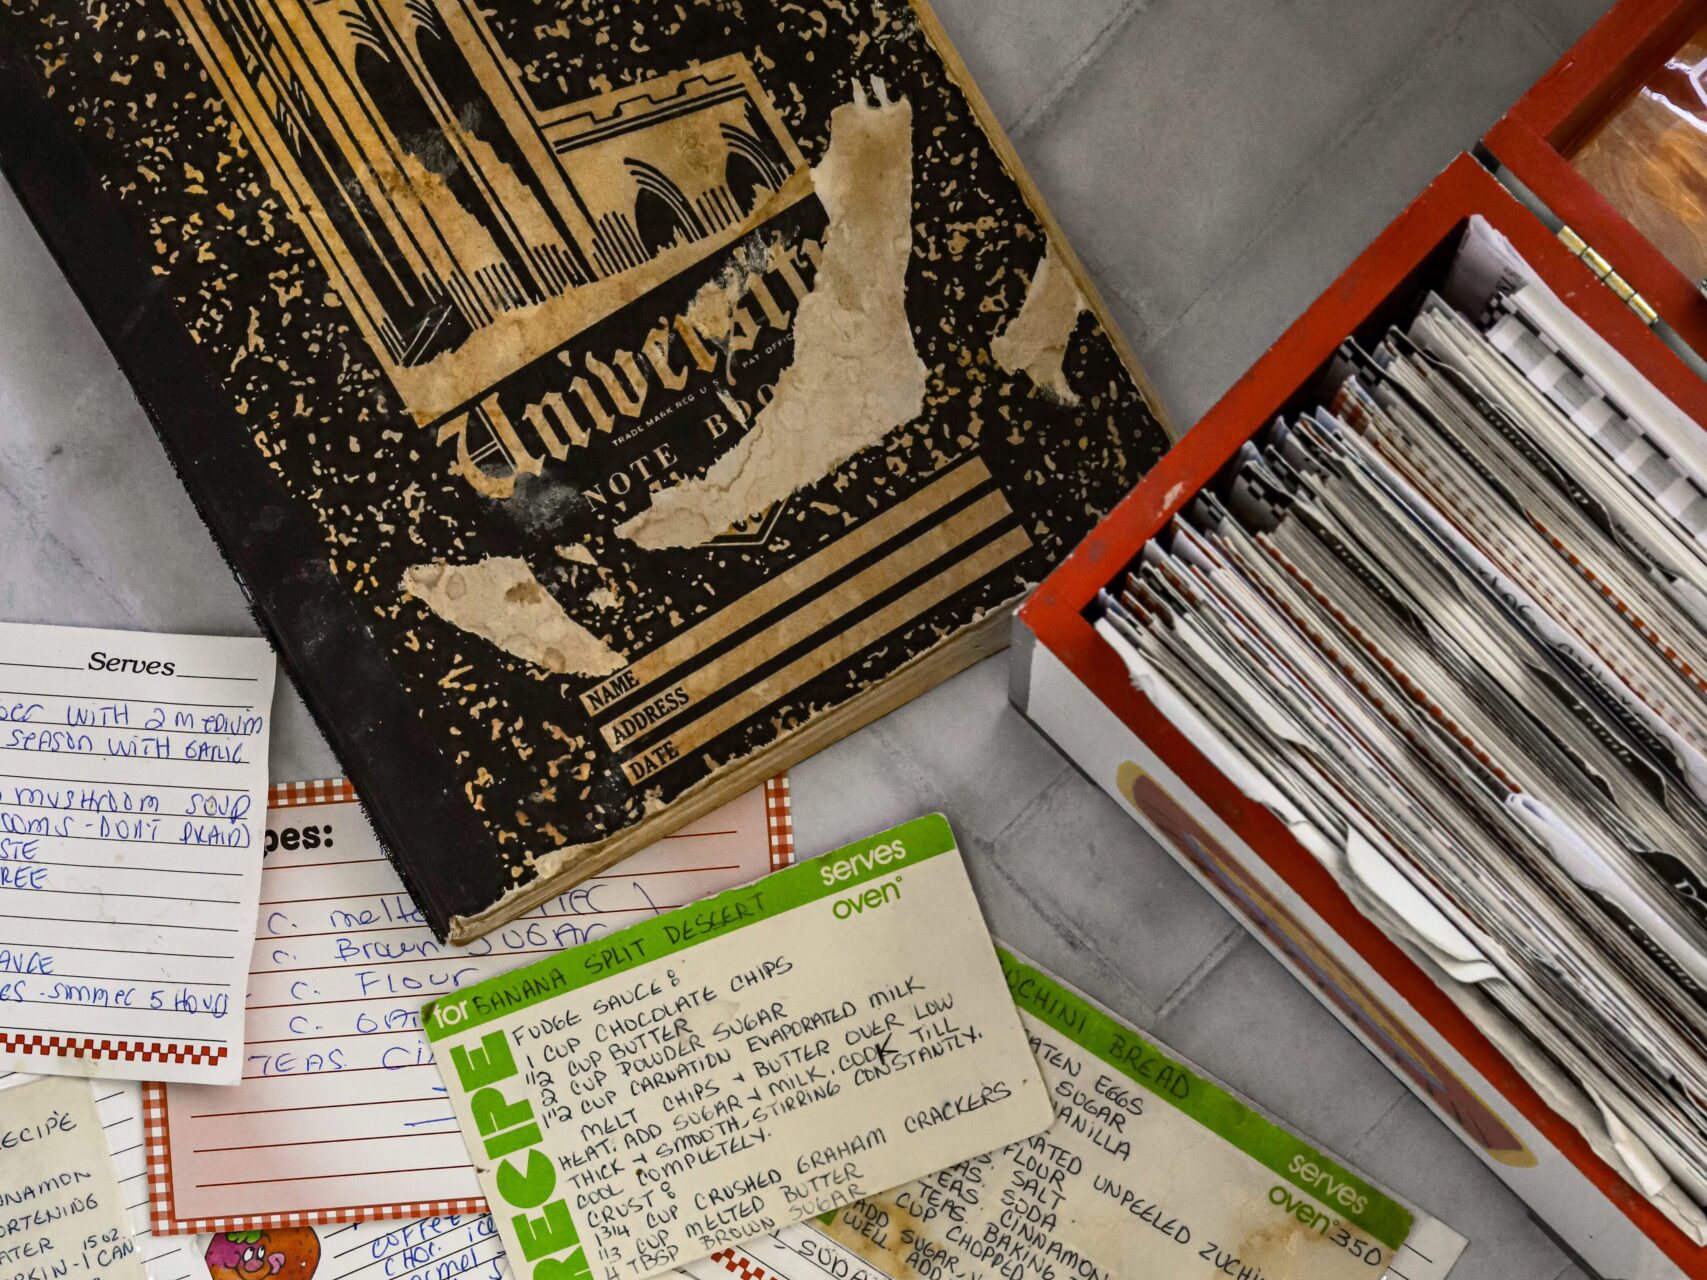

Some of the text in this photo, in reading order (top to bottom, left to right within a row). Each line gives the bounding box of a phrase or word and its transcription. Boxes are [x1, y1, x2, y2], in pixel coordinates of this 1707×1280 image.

[612, 426, 644, 447] TRADE
[647, 407, 674, 429] MARK
[675, 394, 695, 410] REG
[742, 353, 761, 368] PAT
[581, 442, 680, 514] NOTE
[87, 652, 175, 677] Serves
[588, 669, 641, 712] NAME
[611, 686, 691, 746] ADDRESS
[629, 739, 681, 782] DATE
[820, 839, 907, 886] serves
[472, 970, 568, 1016] BANANA
[584, 938, 648, 975] SPLIT
[433, 997, 470, 1027] for
[512, 1010, 582, 1046] FUDGE
[595, 986, 717, 1042] CHOCOLATE
[747, 1002, 856, 1052] EVAPORATED
[609, 1018, 693, 1060] BUTTER
[616, 1035, 706, 1076] POWDER
[581, 993, 954, 1141] MELT BUTTER OVER LOW
[1106, 1033, 1194, 1101] BREAD
[625, 1124, 661, 1150] ADD
[695, 1081, 1011, 1212] CRUSHED GRAHAM CRACKERS
[570, 1160, 624, 1191] THICK
[1003, 1144, 1068, 1191] FLOUR
[1288, 1151, 1370, 1216] serves
[577, 1180, 624, 1210] COOL
[1001, 1189, 1058, 1231] SODA
[1010, 1171, 1068, 1211] SALT
[686, 1195, 765, 1239] MELTED
[626, 1217, 775, 1275] TBSP BROWN
[1330, 1222, 1384, 1268] 350
